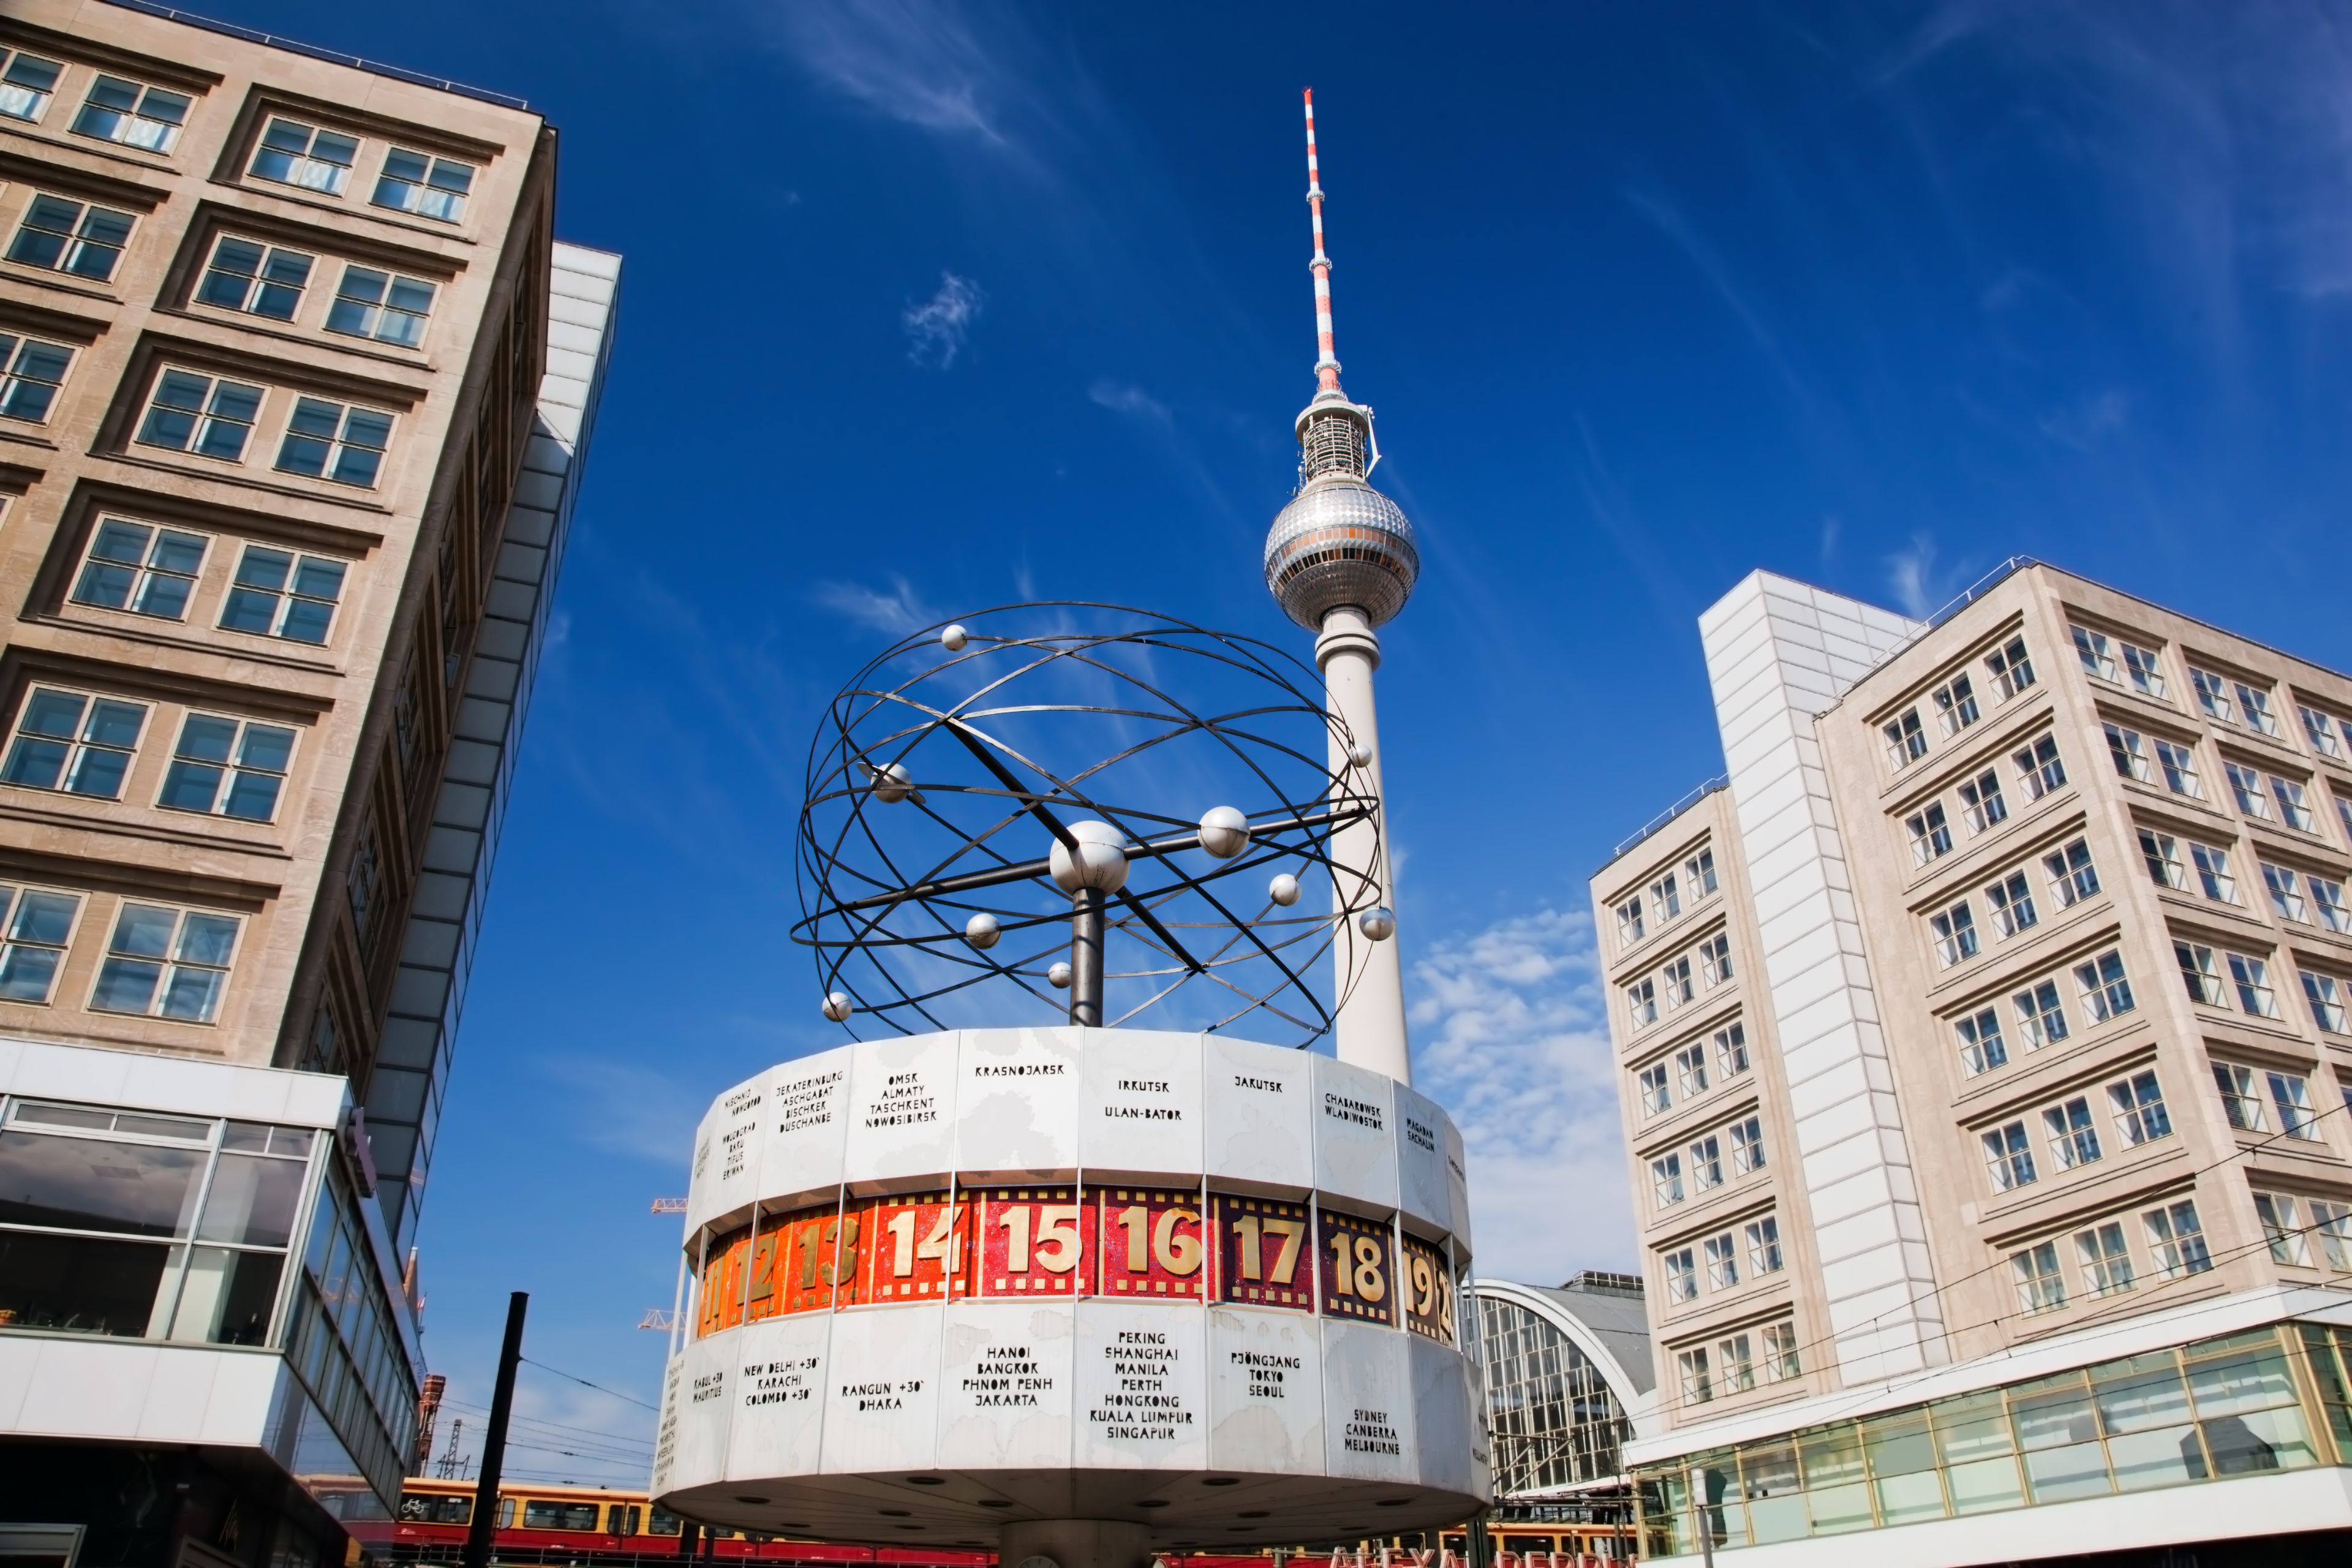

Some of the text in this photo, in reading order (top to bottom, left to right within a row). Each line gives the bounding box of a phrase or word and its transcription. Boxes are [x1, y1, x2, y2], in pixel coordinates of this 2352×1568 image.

[889, 1072, 918, 1085] OMSK
[975, 1065, 1065, 1077] KRASNOJARSK
[776, 1071, 843, 1096] JEKATERINBURG
[1118, 1080, 1170, 1093] IRKUTSK
[1235, 1076, 1283, 1093] JAKUTSK
[725, 1089, 751, 1109] NISCHNIJ
[783, 1086, 834, 1107] ASCHGABAT
[881, 1085, 924, 1099] ALMATY
[732, 1096, 761, 1117] NOWGOROD
[786, 1101, 826, 1119] BISCHKEK
[870, 1098, 934, 1114] TASCHKENT
[1105, 1107, 1182, 1120] ULAN-BATOR
[1325, 1093, 1381, 1118] CHABAROWSK
[780, 1112, 831, 1133] DUSCHANBE
[865, 1111, 937, 1129] NOWOSIBIRSK
[1325, 1105, 1384, 1131] WLADIWOSTOK
[723, 1122, 756, 1145] WOLGOGRAD
[1407, 1118, 1434, 1140] MAGADAN
[729, 1139, 744, 1153] BAKU
[728, 1152, 743, 1166] TIFLIS
[723, 1164, 744, 1180] ERIWAN
[888, 1206, 963, 1276] 14
[1000, 1205, 1082, 1273] 15
[1118, 1205, 1202, 1275] 16
[799, 1218, 858, 1287] 13
[1233, 1215, 1306, 1284] 17
[737, 1235, 778, 1305] 12
[1330, 1231, 1384, 1302] 18
[1403, 1251, 1433, 1316] 19
[1118, 1332, 1166, 1344] PEKING
[987, 1346, 1030, 1359] HANOI
[1105, 1347, 1178, 1360] SHANGHAI
[1231, 1351, 1300, 1369] PJÖNGJANG
[744, 1365, 764, 1377] NEW
[769, 1360, 795, 1374] DELHI
[978, 1362, 1039, 1374] BANGKOK
[1115, 1363, 1169, 1376] MANILA
[1250, 1369, 1283, 1382] TOKYO
[694, 1375, 710, 1390] KABUL
[758, 1374, 802, 1390] KARACHI
[842, 1383, 891, 1396] RANGUN
[963, 1378, 1053, 1390] PHNOM PENH
[1121, 1379, 1162, 1391] PERTH
[693, 1386, 722, 1404] MAURITIUS
[746, 1392, 787, 1406] COLOMBO
[1250, 1384, 1284, 1398] SEOUL
[859, 1398, 902, 1411] DHAKA
[975, 1394, 1038, 1406] JAKARTA
[1105, 1394, 1180, 1408] HONGKONG
[1090, 1410, 1193, 1424] KUALA LUMPUR
[1354, 1409, 1388, 1424] SYDNEY
[1107, 1427, 1175, 1439] SINGAPUR
[1346, 1423, 1397, 1440] CANBERRA
[1344, 1438, 1400, 1455] MELBOURNE
